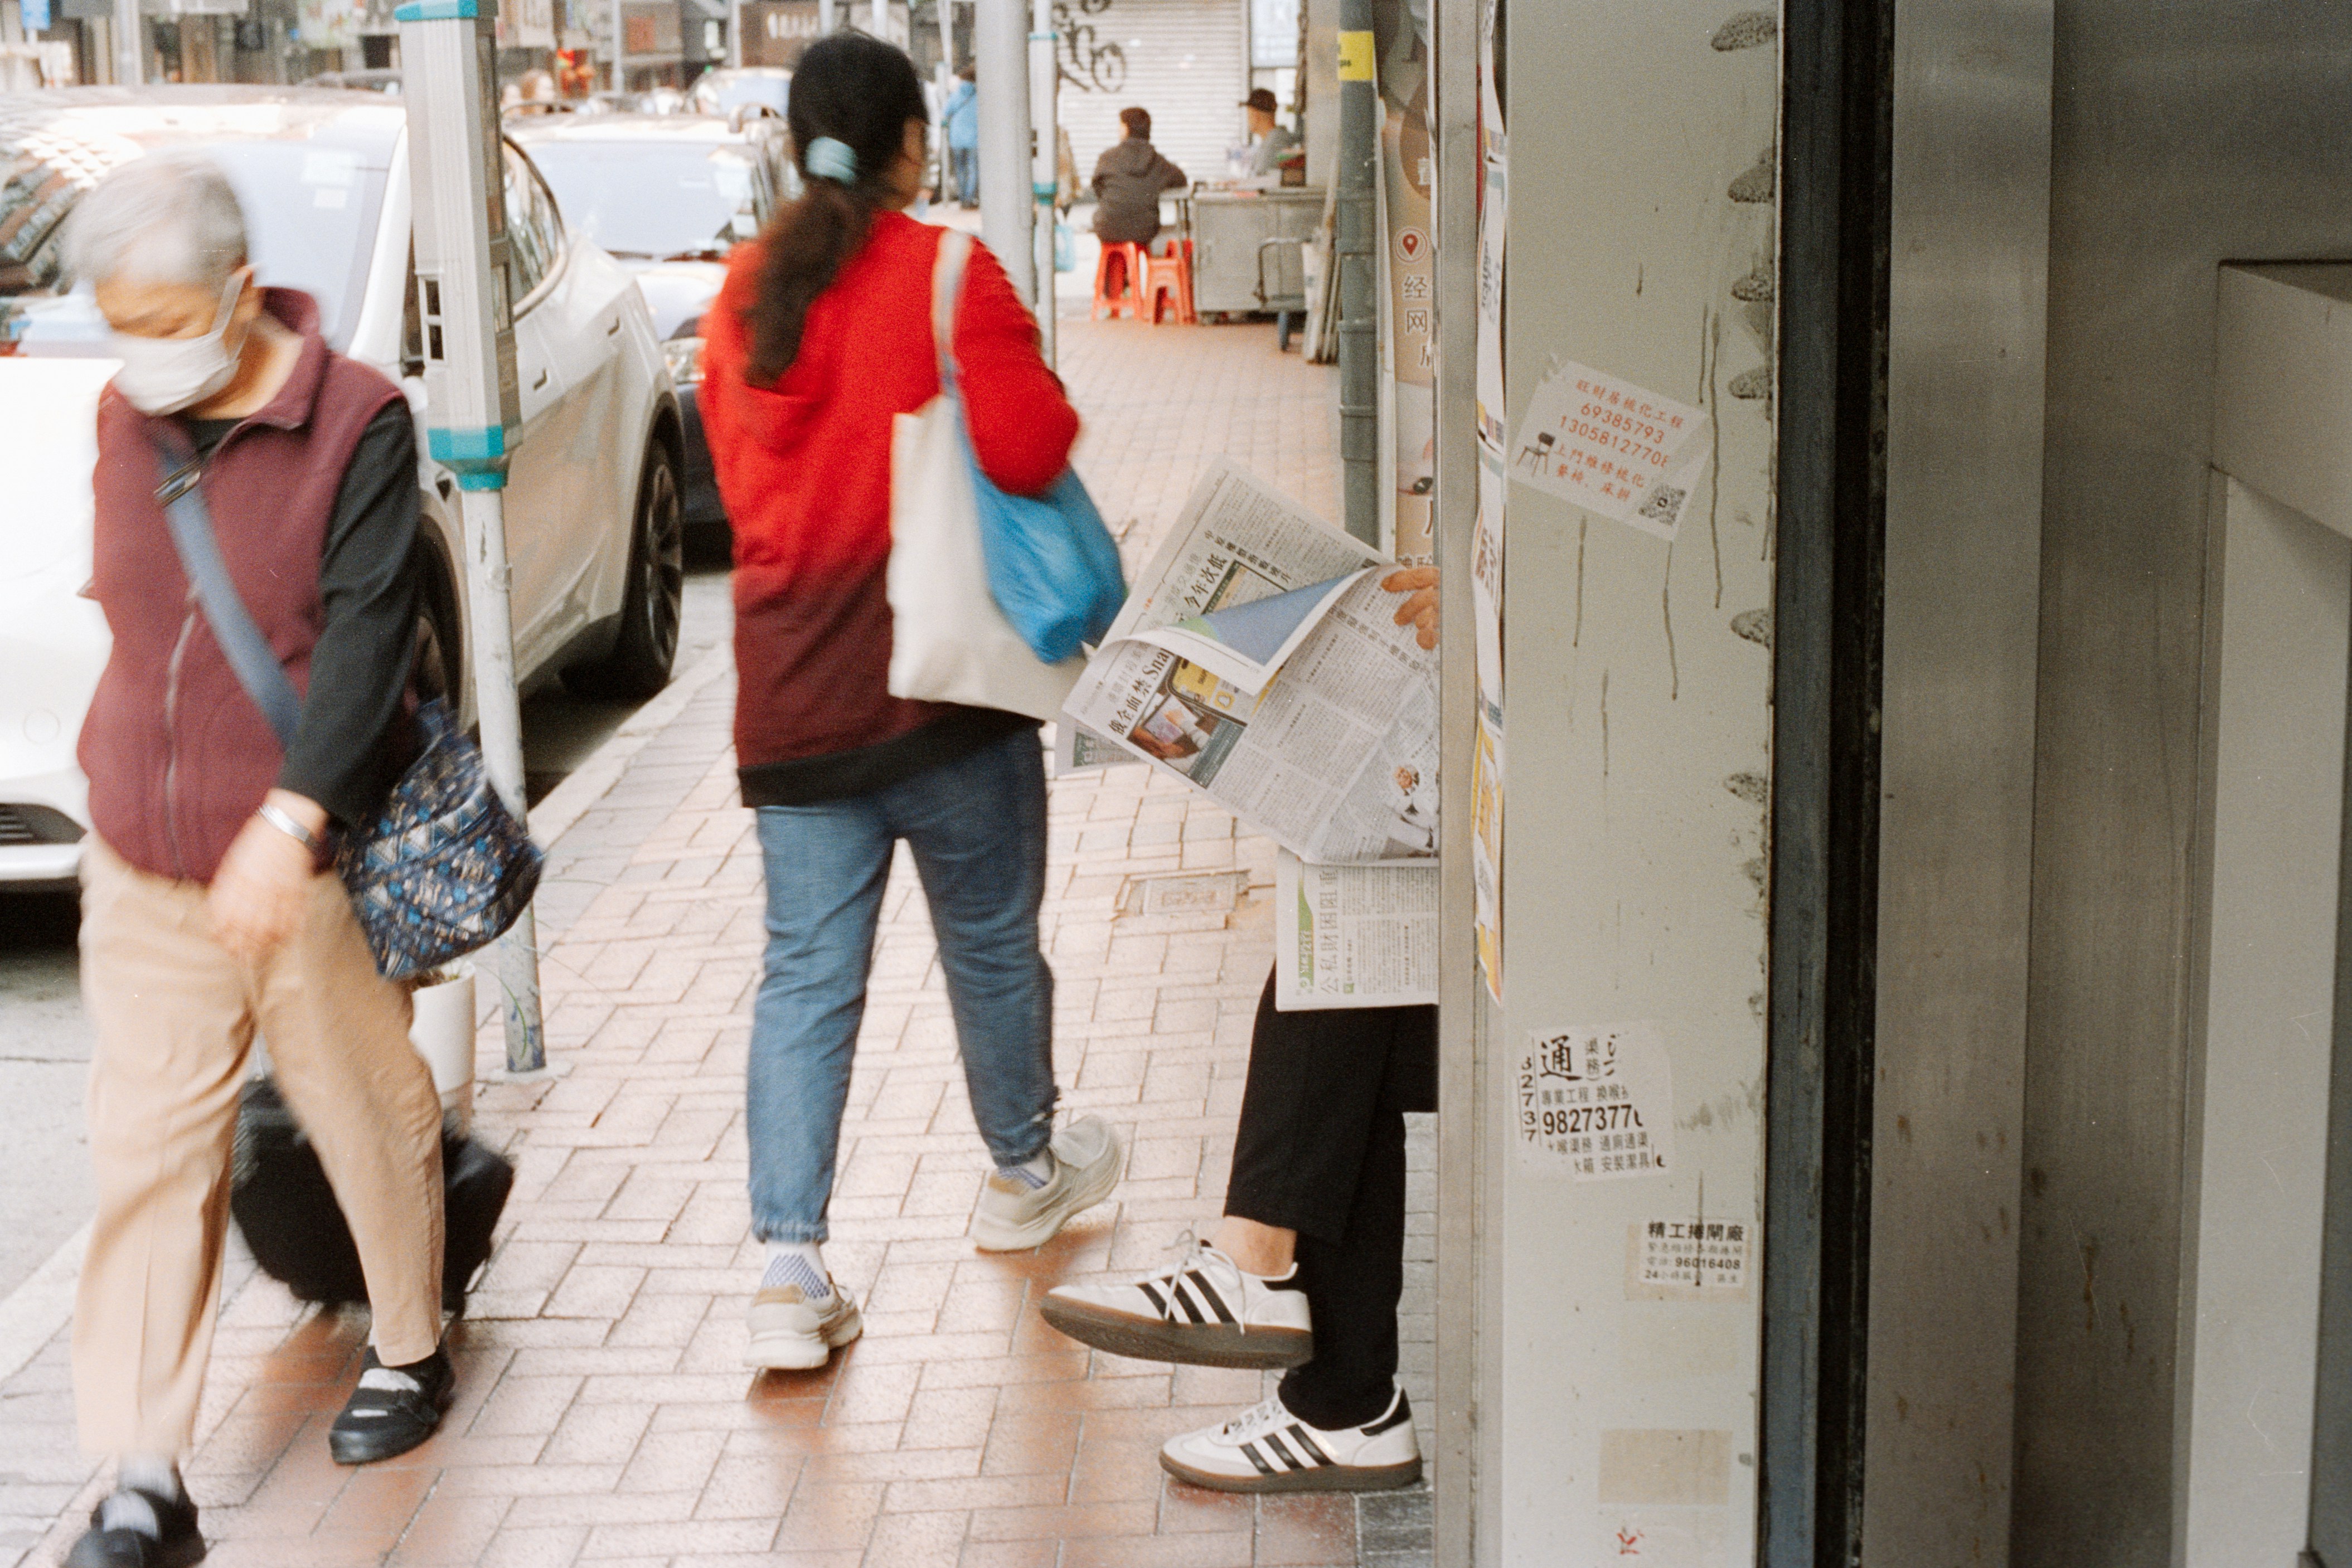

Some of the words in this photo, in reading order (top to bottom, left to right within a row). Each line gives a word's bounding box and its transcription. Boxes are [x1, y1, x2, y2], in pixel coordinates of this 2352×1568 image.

[1580, 403, 1664, 444] 69385793
[1182, 554, 1228, 610] 今年次低
[1539, 1035, 1582, 1081] 通
[1675, 1256, 1740, 1270] 96016408
